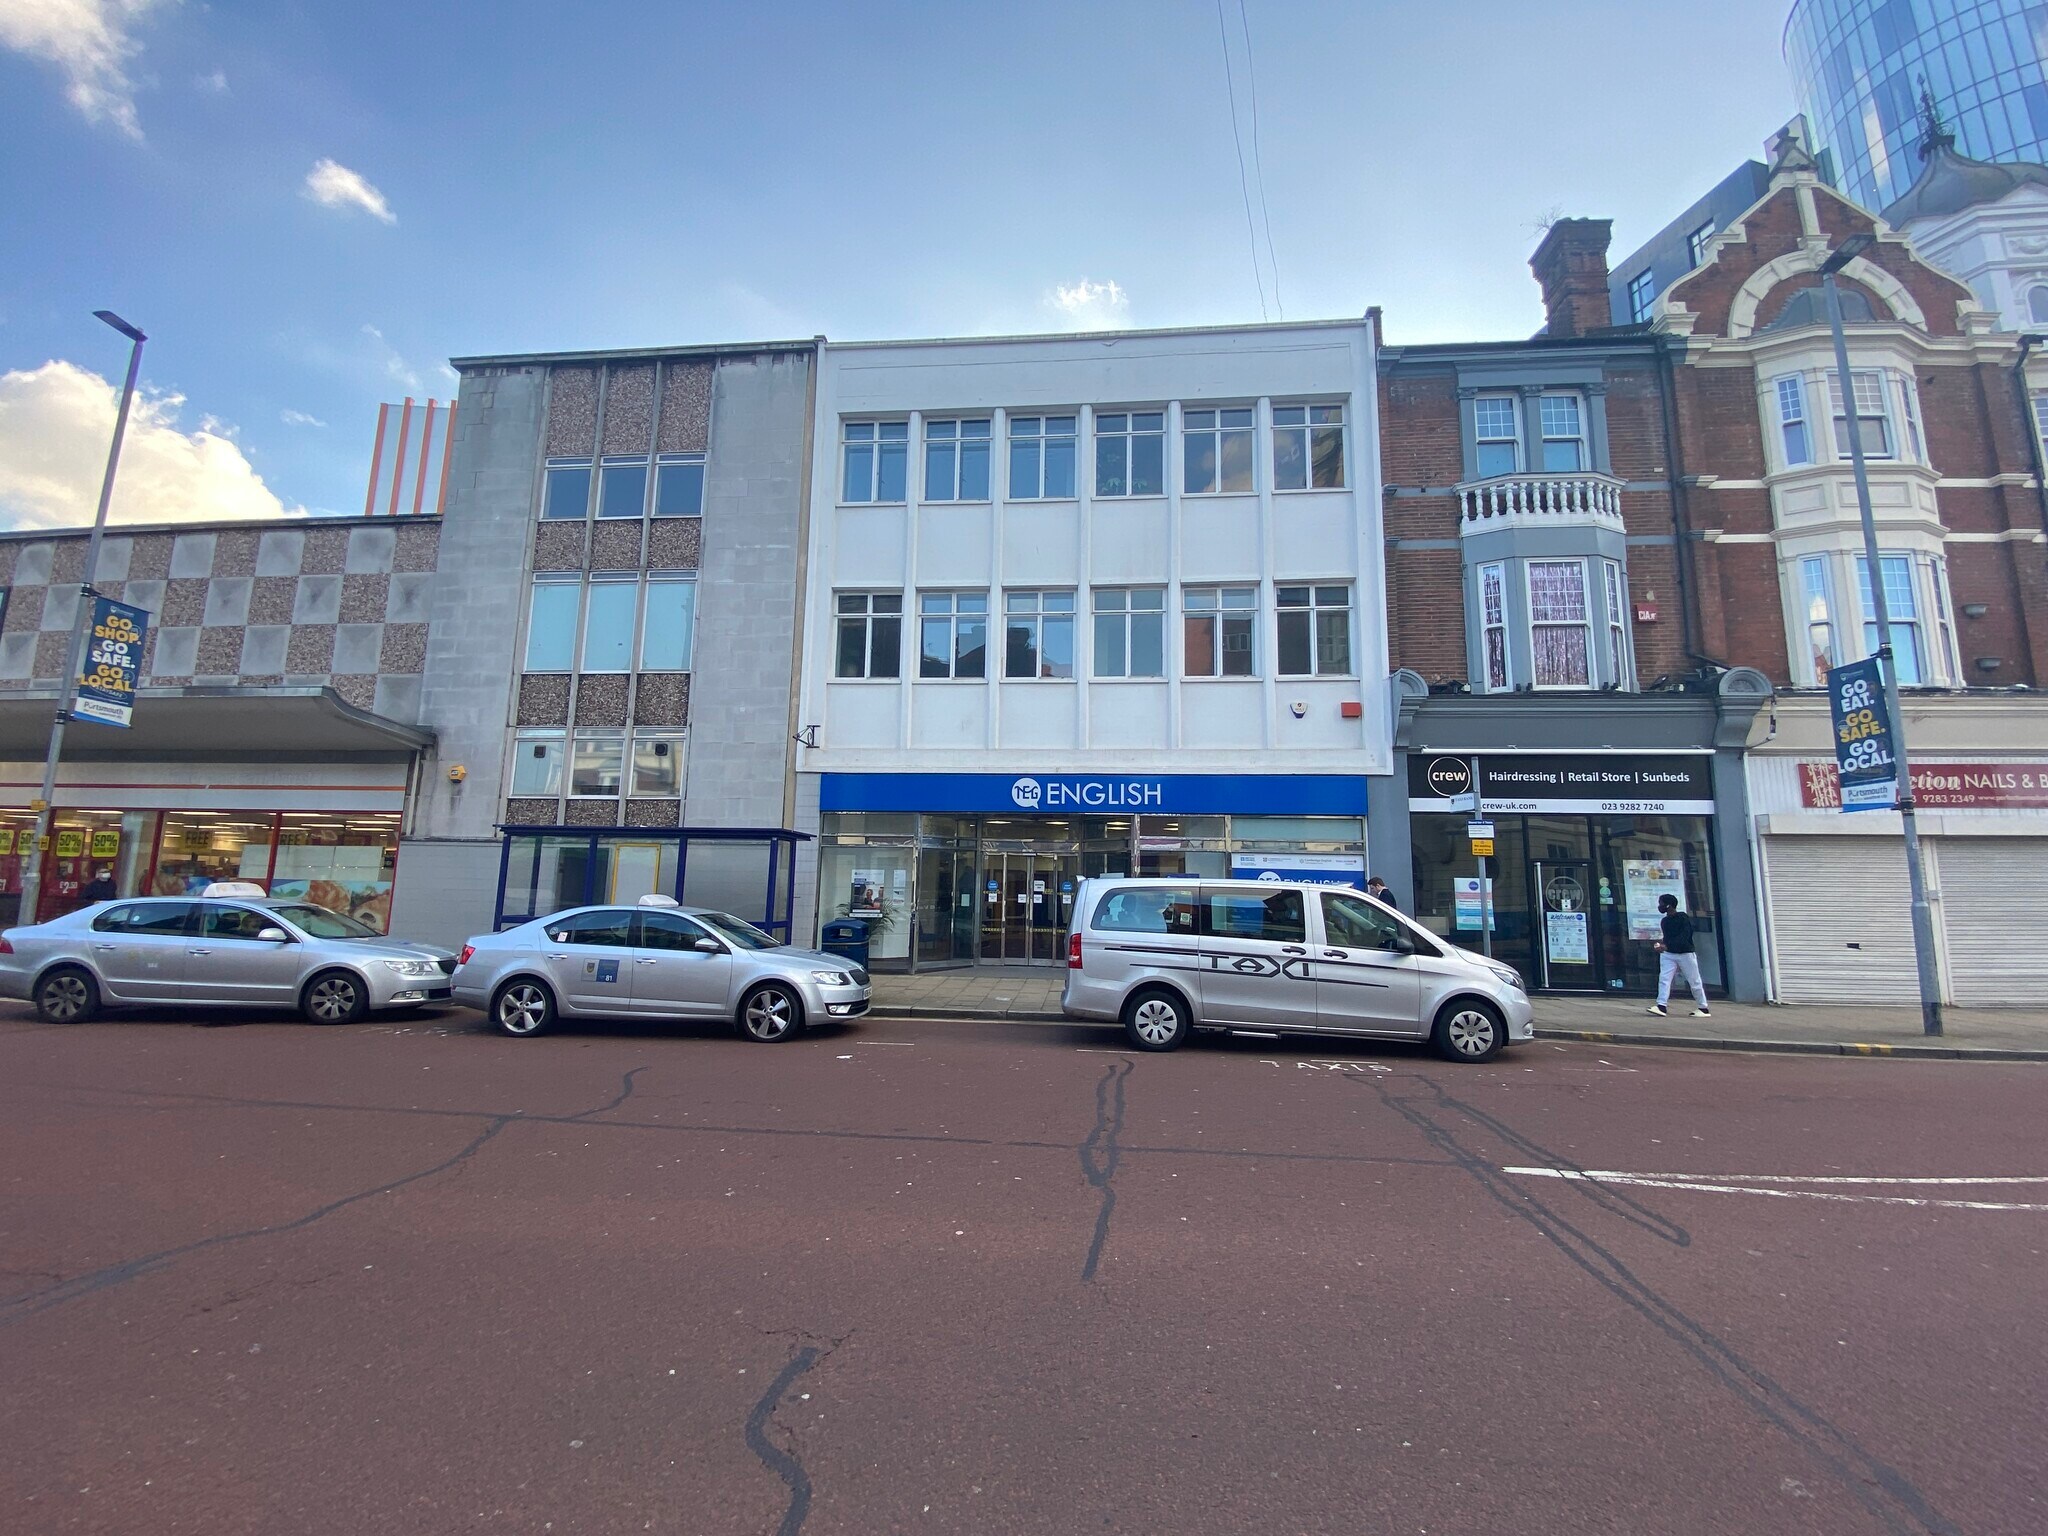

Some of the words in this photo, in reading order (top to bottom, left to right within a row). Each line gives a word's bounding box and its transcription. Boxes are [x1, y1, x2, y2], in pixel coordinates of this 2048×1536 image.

[106, 615, 132, 630] GO
[95, 625, 141, 645] SHOP.
[102, 640, 128, 654] GO
[92, 650, 136, 668] SAFE.
[97, 665, 123, 679] GO
[80, 674, 135, 692] LOCAL.
[1841, 679, 1867, 698] GO
[84, 701, 124, 715] Portsmouth
[1841, 692, 1874, 712] EAT.
[1846, 709, 1872, 727] GO
[1840, 721, 1886, 742] SAFE.
[1849, 739, 1877, 756] GO
[1838, 751, 1896, 774] LOCAL.
[1432, 770, 1466, 781] crew
[1489, 771, 1556, 783] Hairdressing
[1568, 772, 1599, 782] Retail
[1602, 772, 1631, 782] Store
[1642, 772, 1690, 782] Sunbeds
[1908, 771, 1961, 790] ction
[1964, 774, 2016, 788] NAILS
[2022, 774, 2034, 788] &
[1047, 783, 1161, 805] ENGLISH
[1848, 786, 1888, 797] Portsmouth
[1923, 794, 1948, 803] 9283
[1951, 794, 1975, 803] 2349
[1602, 803, 1617, 811] 023
[1620, 803, 1641, 811] 9282
[1643, 803, 1664, 811] 7240
[60, 834, 81, 846] 50%
[94, 834, 117, 846] 50%
[1201, 954, 1309, 980] TAXI
